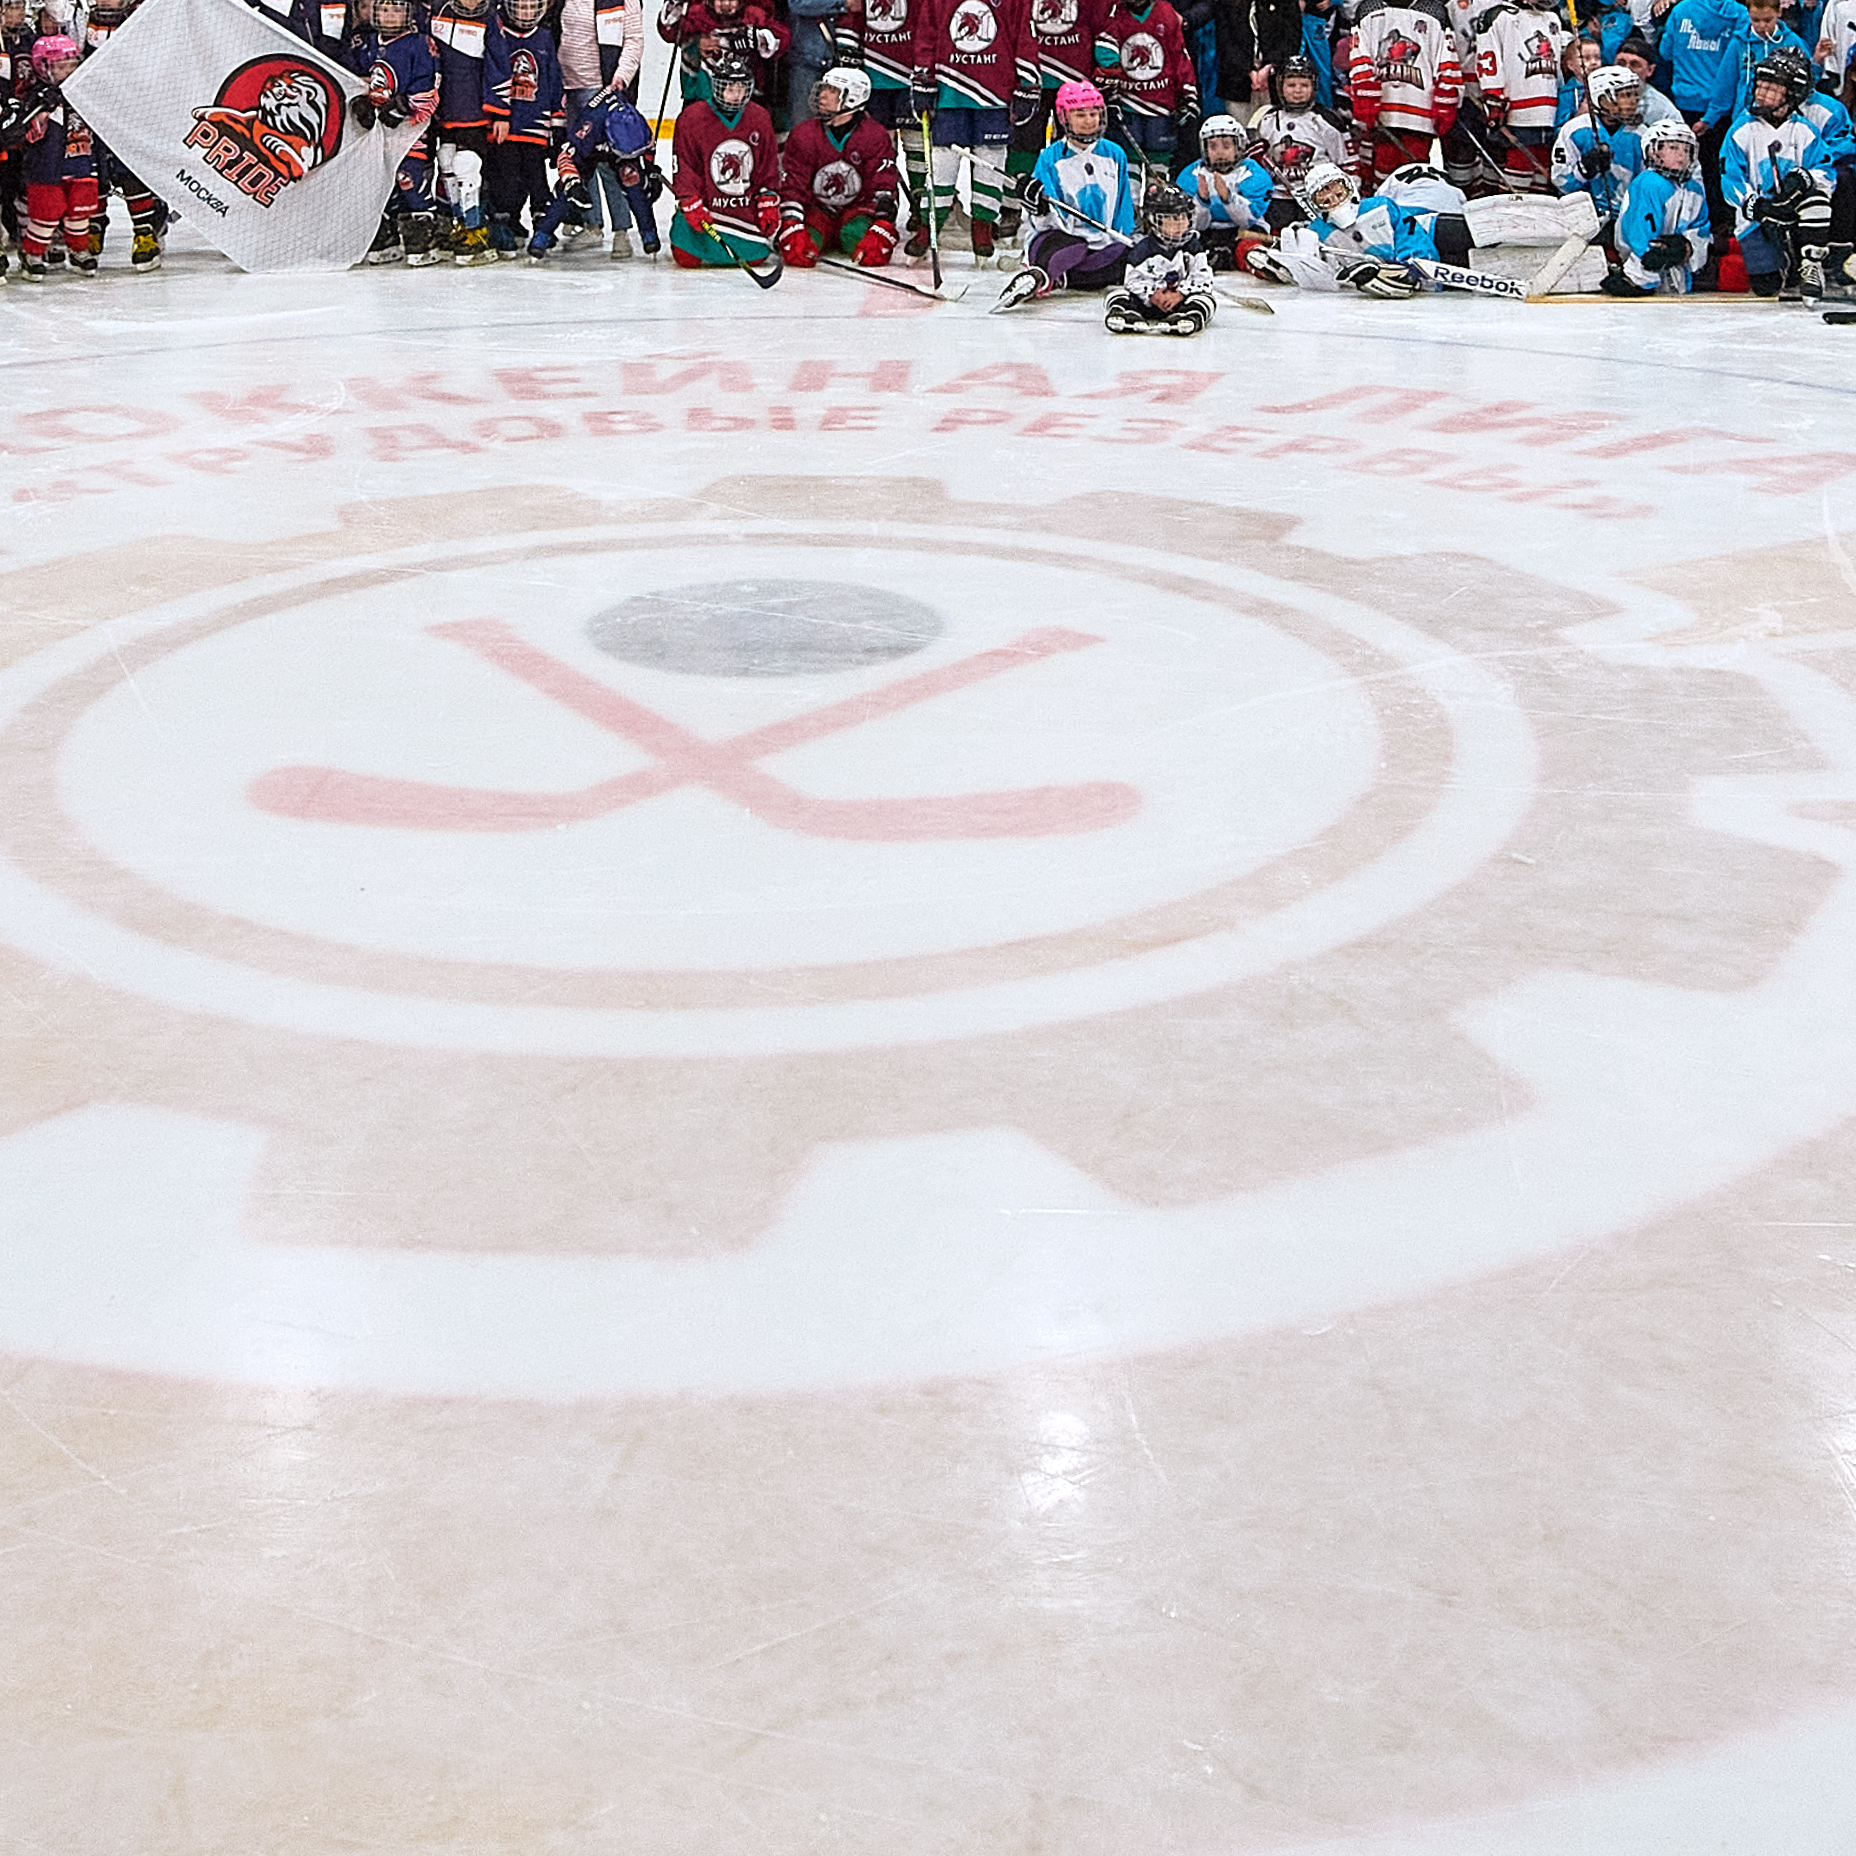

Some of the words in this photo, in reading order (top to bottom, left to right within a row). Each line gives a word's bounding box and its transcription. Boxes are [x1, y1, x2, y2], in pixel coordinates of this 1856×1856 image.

[1038, 33, 1080, 45] УСТАНГ
[183, 121, 289, 208] PRIDE
[1554, 148, 1566, 164] 5
[175, 169, 230, 218] МОСКВА
[1433, 266, 1523, 296] Reebok
